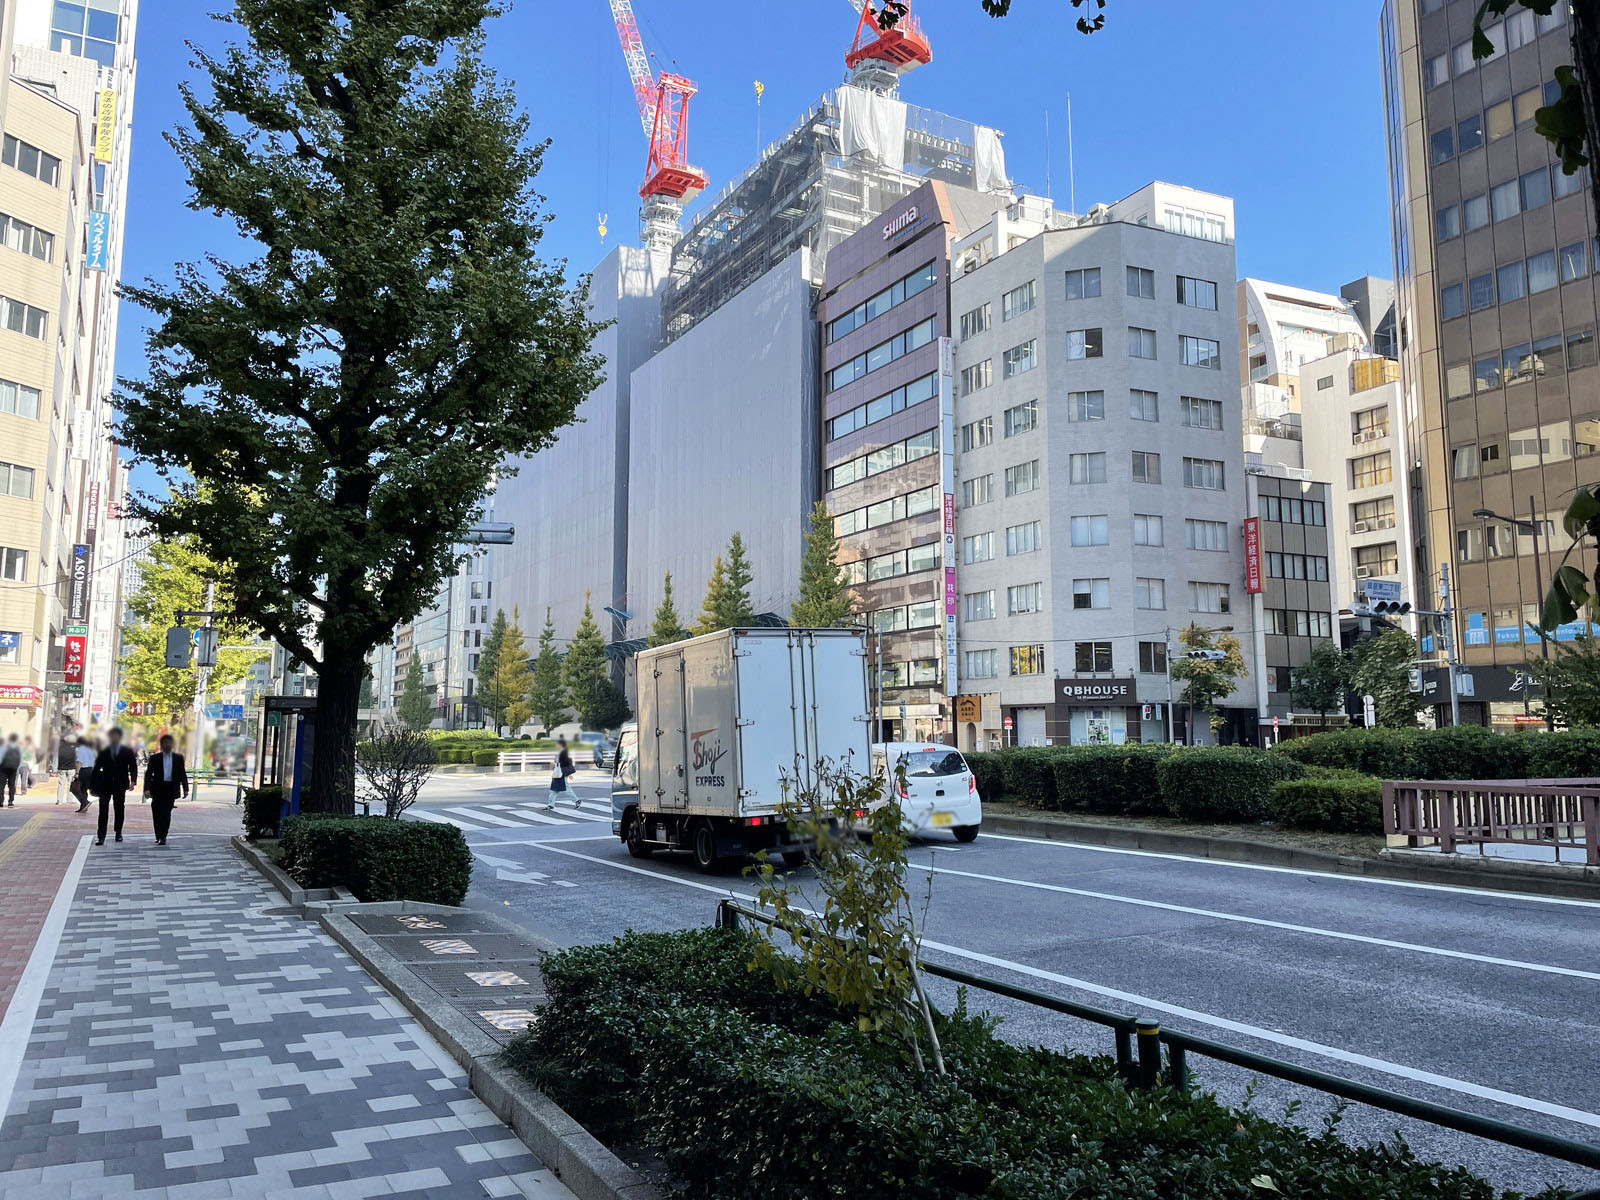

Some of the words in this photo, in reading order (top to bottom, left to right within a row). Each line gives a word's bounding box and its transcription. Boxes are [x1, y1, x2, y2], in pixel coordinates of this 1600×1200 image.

[90, 212, 105, 268] リベラルタイム
[74, 557, 85, 580] ASO
[1247, 521, 1259, 590] 東洋経済日報
[67, 640, 81, 677] なか卯
[692, 740, 728, 775] Shoji
[695, 776, 725, 787] EXPRESS
